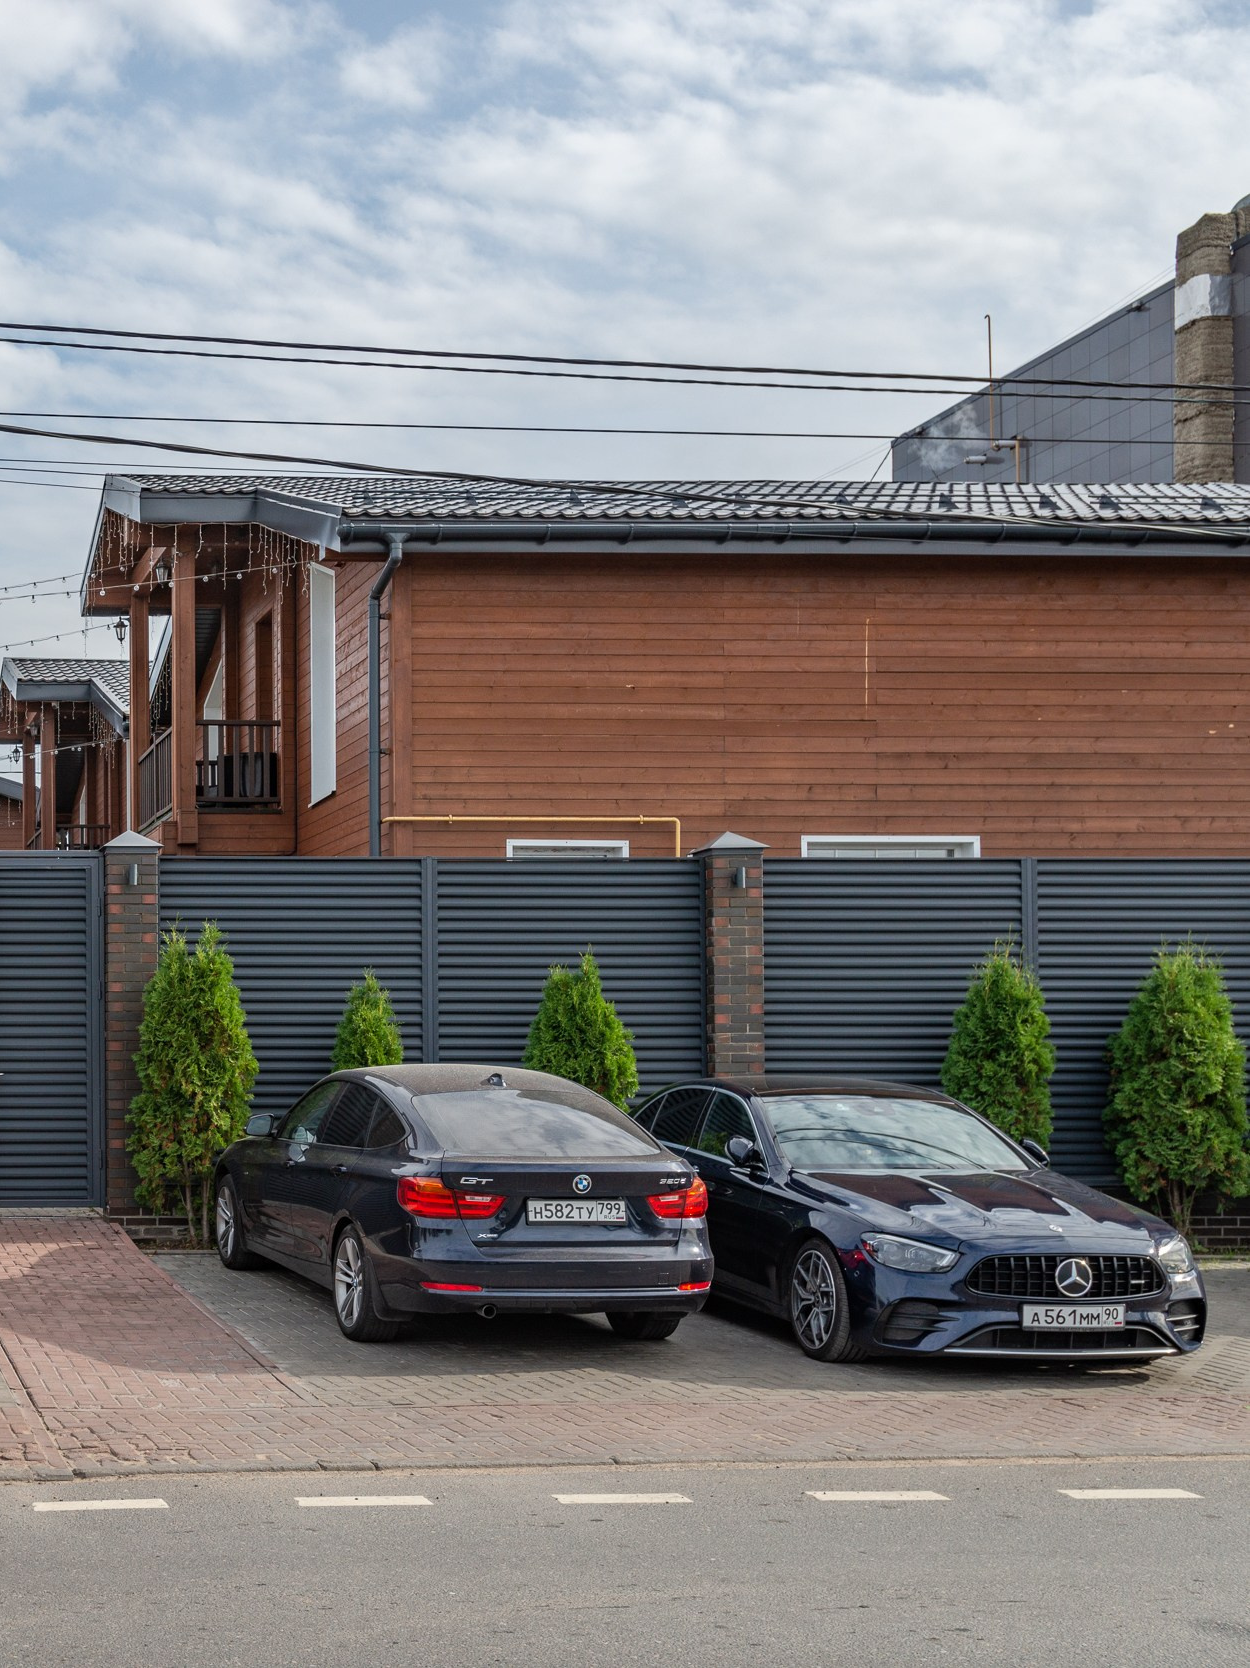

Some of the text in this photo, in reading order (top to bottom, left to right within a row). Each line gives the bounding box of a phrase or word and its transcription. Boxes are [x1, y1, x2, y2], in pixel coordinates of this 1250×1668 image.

[460, 1176, 494, 1185] GT
[597, 1202, 621, 1215] 799
[1104, 1307, 1119, 1321] 90
